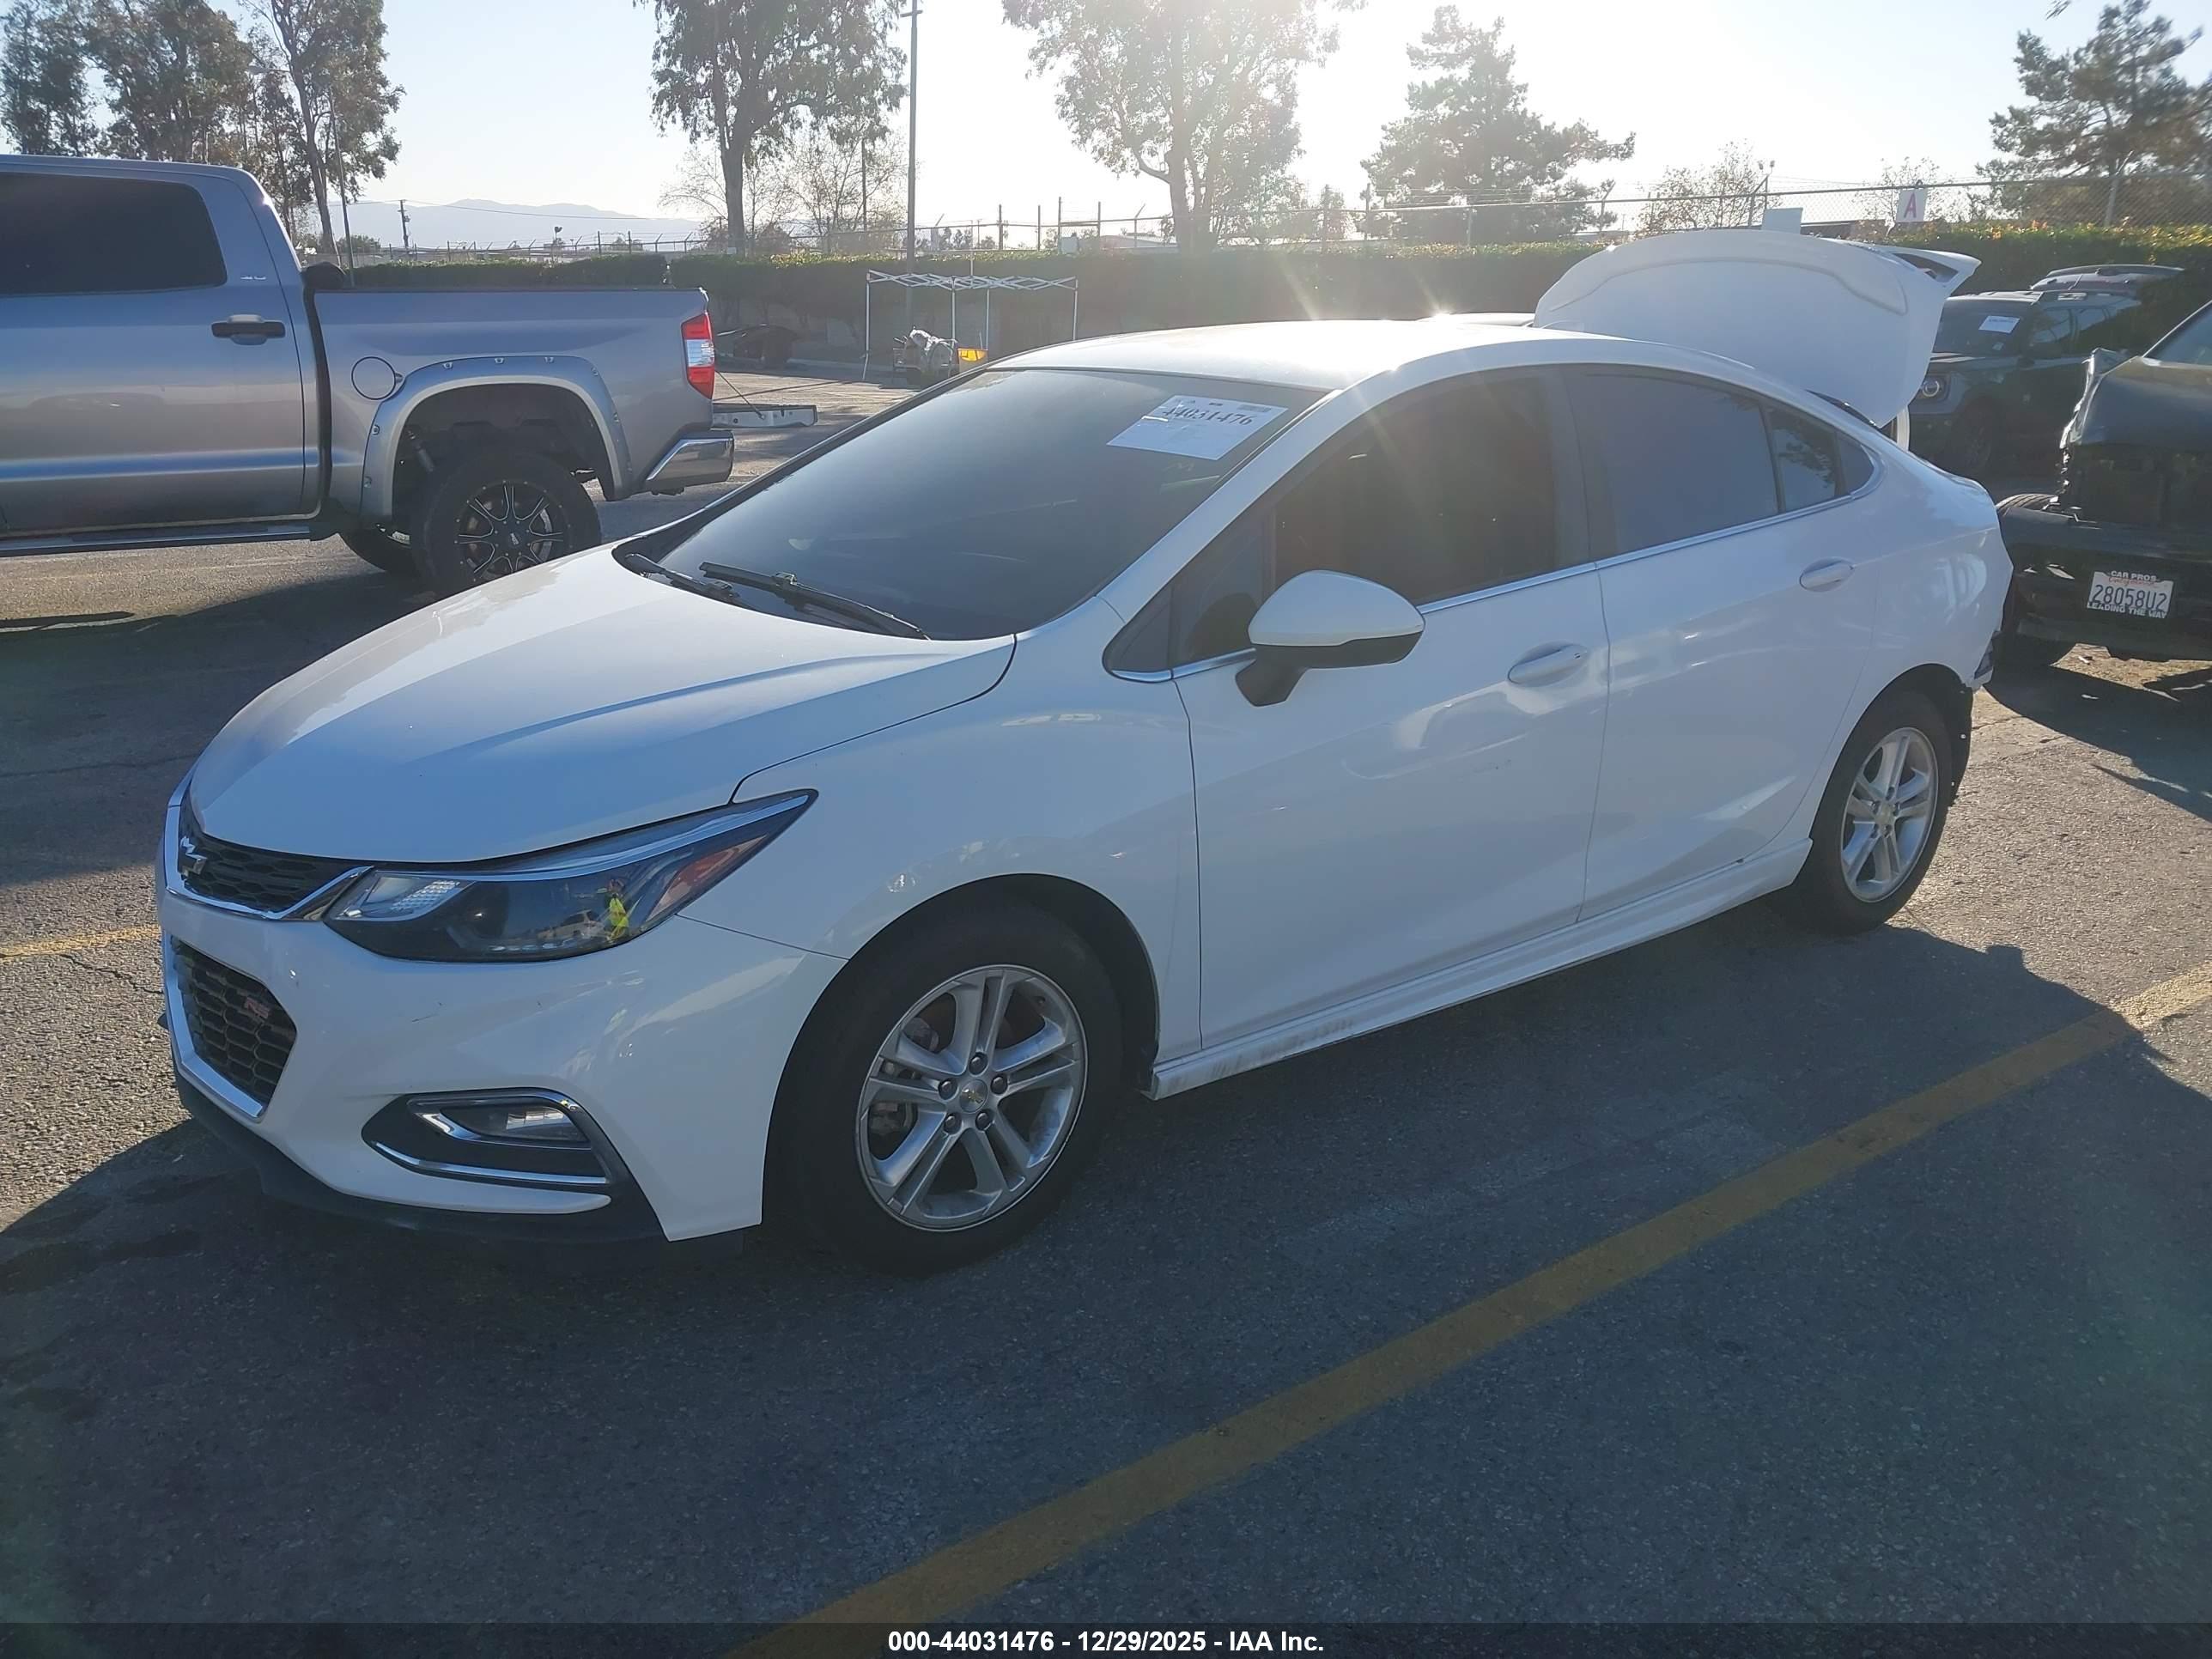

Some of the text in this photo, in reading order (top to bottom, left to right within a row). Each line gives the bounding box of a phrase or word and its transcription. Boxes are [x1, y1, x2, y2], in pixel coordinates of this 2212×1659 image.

[1903, 192, 1917, 218] A
[1163, 406, 1253, 426] 44031476
[2111, 570, 2157, 581] CAR PROS
[2092, 584, 2167, 611] 28058U2
[2087, 601, 2167, 619] LEADING THE WAY
